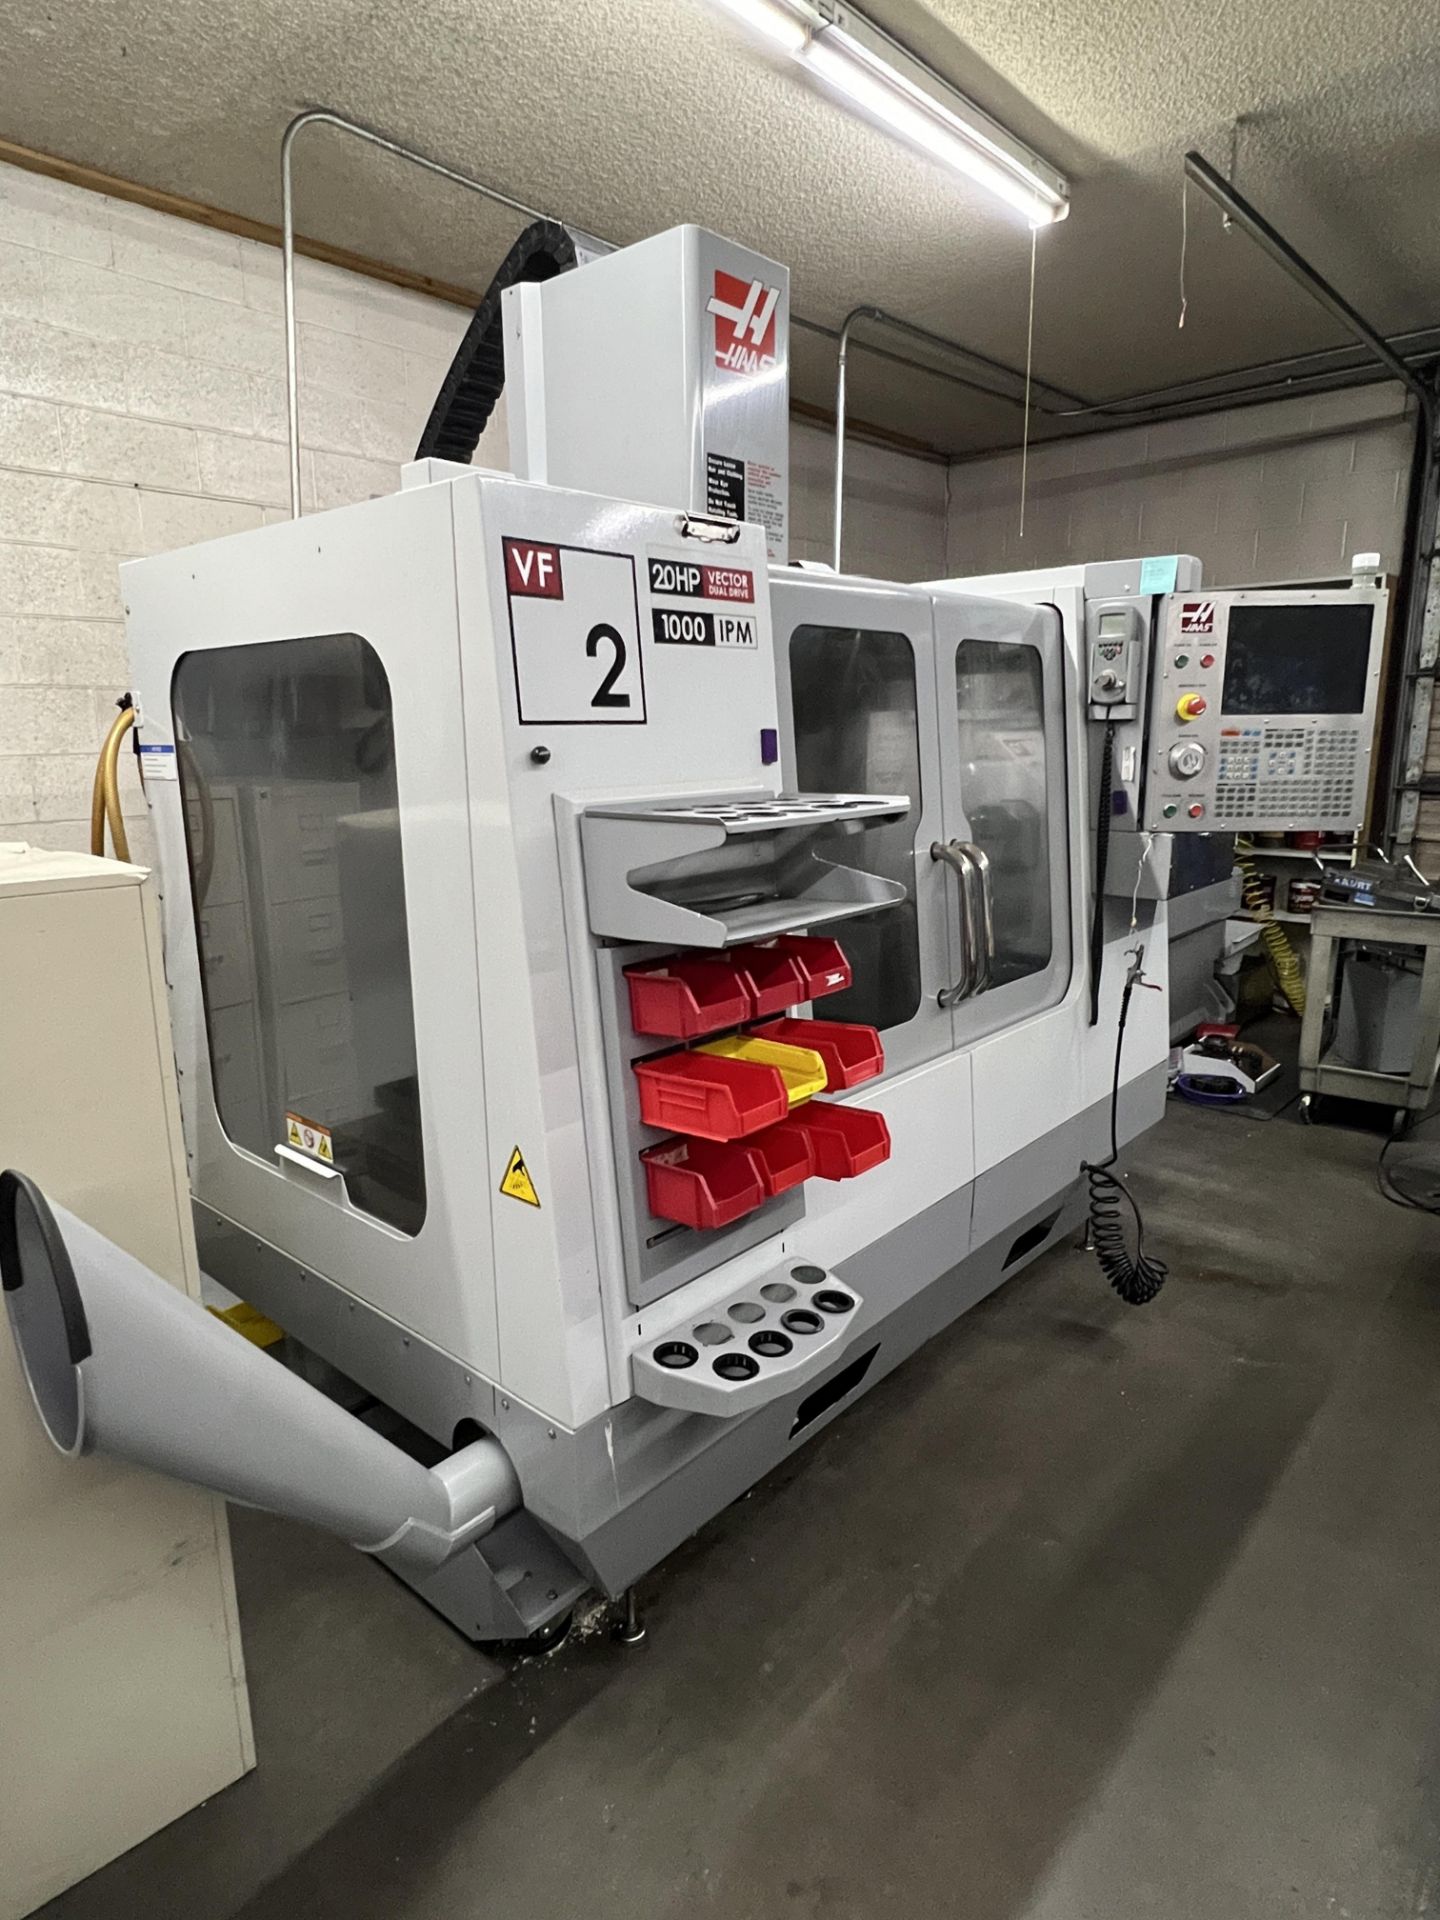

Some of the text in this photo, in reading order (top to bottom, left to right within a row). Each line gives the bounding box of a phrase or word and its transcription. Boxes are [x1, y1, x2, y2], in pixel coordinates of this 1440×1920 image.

[512, 548, 553, 588] VF
[652, 563, 701, 592] 20HP
[707, 570, 748, 588] VECTOR
[708, 585, 749, 599] DUAL DRIVE
[661, 614, 752, 644] 1000 IPM
[1182, 623, 1213, 632] HAAS
[586, 623, 630, 707] 2
